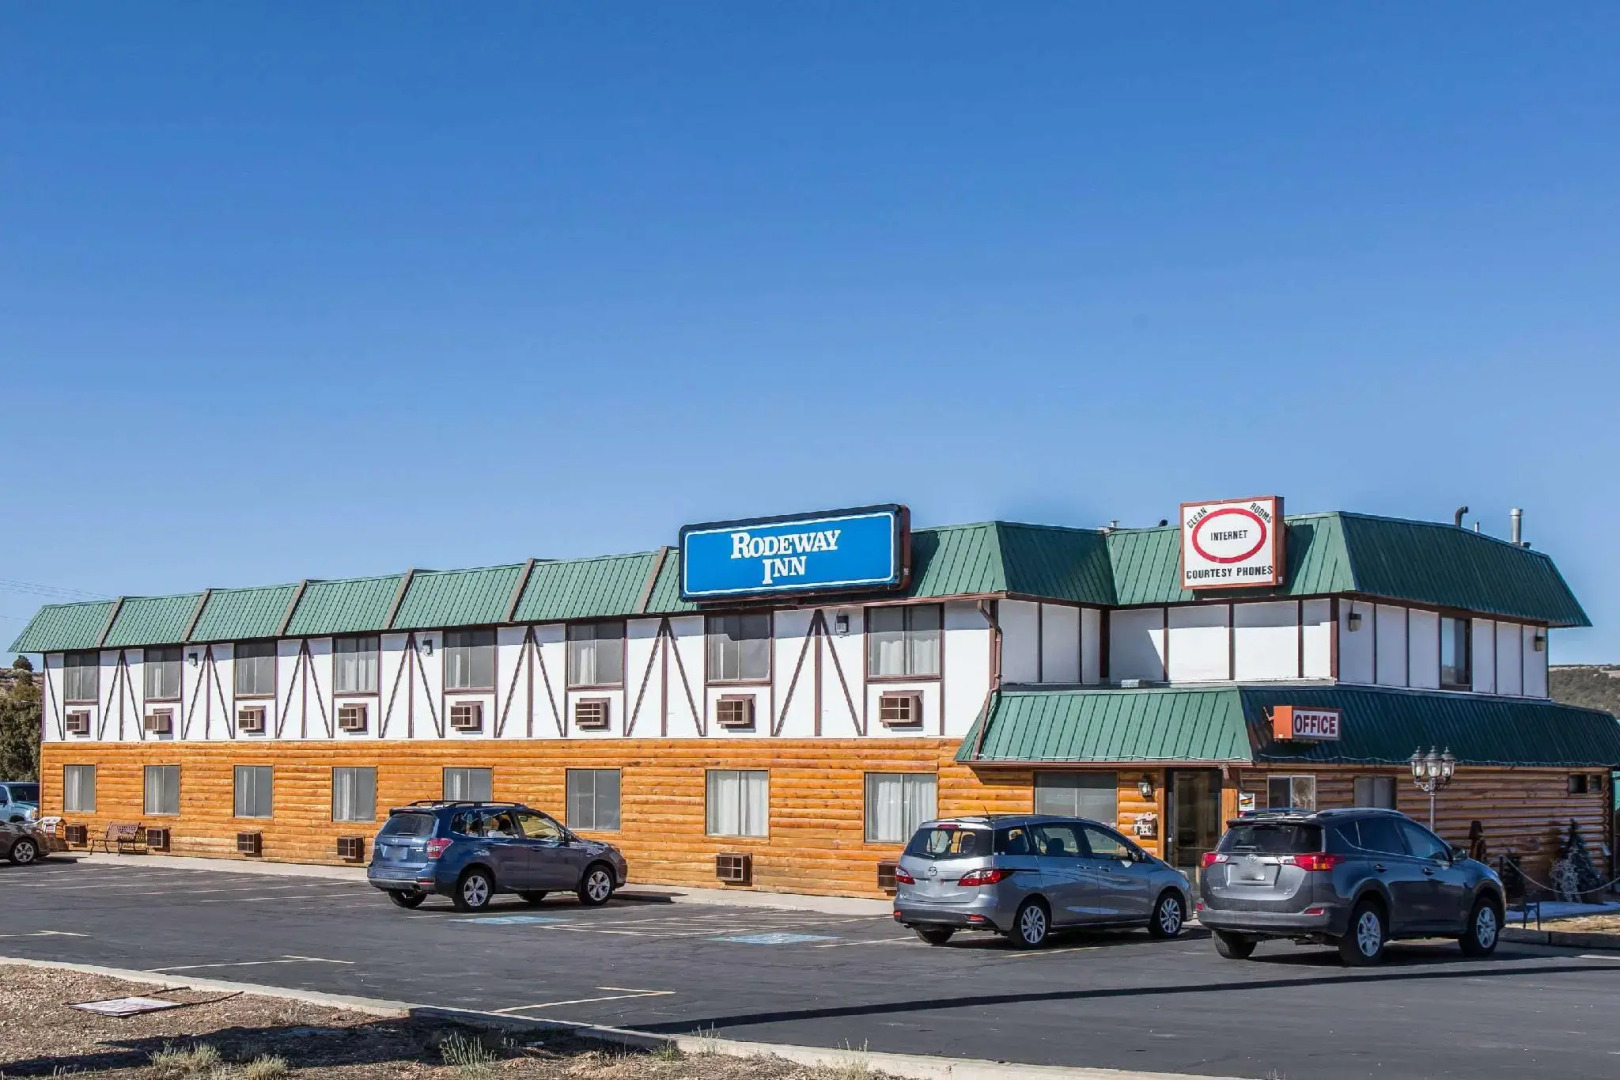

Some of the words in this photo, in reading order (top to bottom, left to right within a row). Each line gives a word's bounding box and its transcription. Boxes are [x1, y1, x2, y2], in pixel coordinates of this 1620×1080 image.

[1187, 507, 1208, 529] CLEAN
[1250, 503, 1273, 524] ROOMS
[730, 529, 841, 559] RODEWAY
[1210, 530, 1248, 541] INTERNET
[762, 556, 807, 585] INN
[1186, 568, 1232, 580] COURTESY
[1236, 565, 1273, 577] PHONES
[1294, 714, 1336, 734] OFFICE
